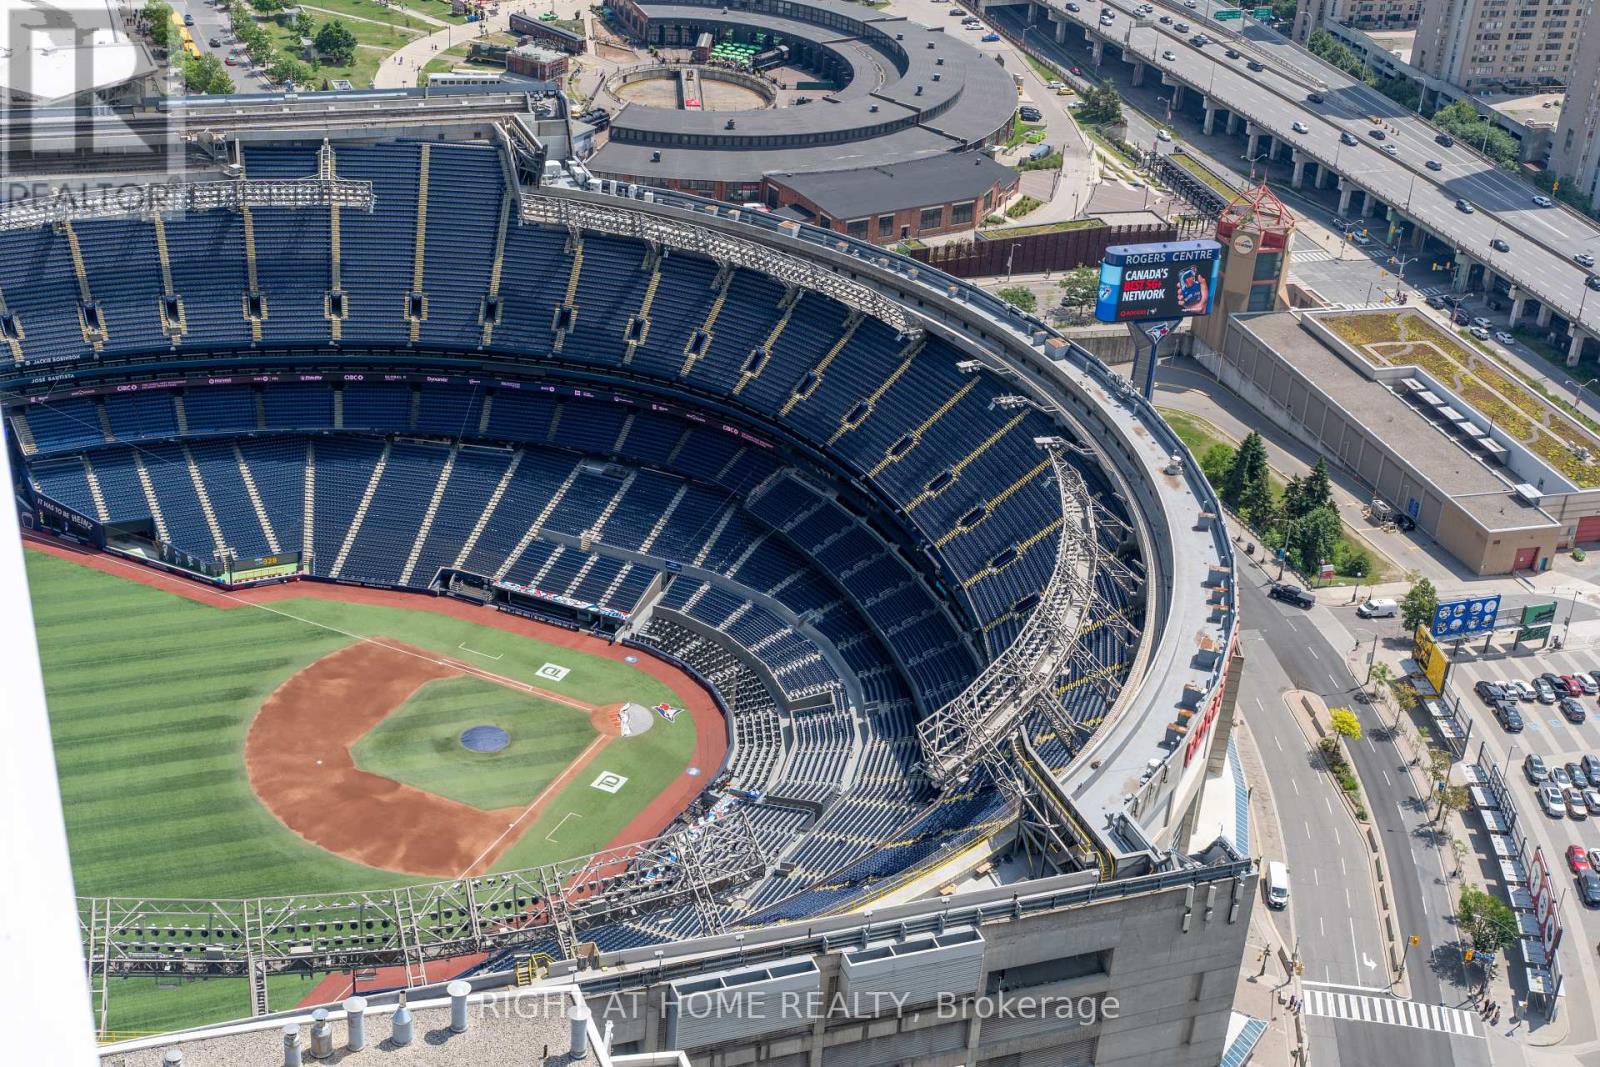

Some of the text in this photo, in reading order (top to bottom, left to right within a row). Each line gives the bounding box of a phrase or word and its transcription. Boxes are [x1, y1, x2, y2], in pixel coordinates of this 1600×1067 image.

[1126, 250, 1213, 265] ROGERS CENTRE
[1125, 268, 1169, 281] CANADA'S
[1122, 289, 1166, 301] NETWORK
[71, 514, 94, 530] HEINZ
